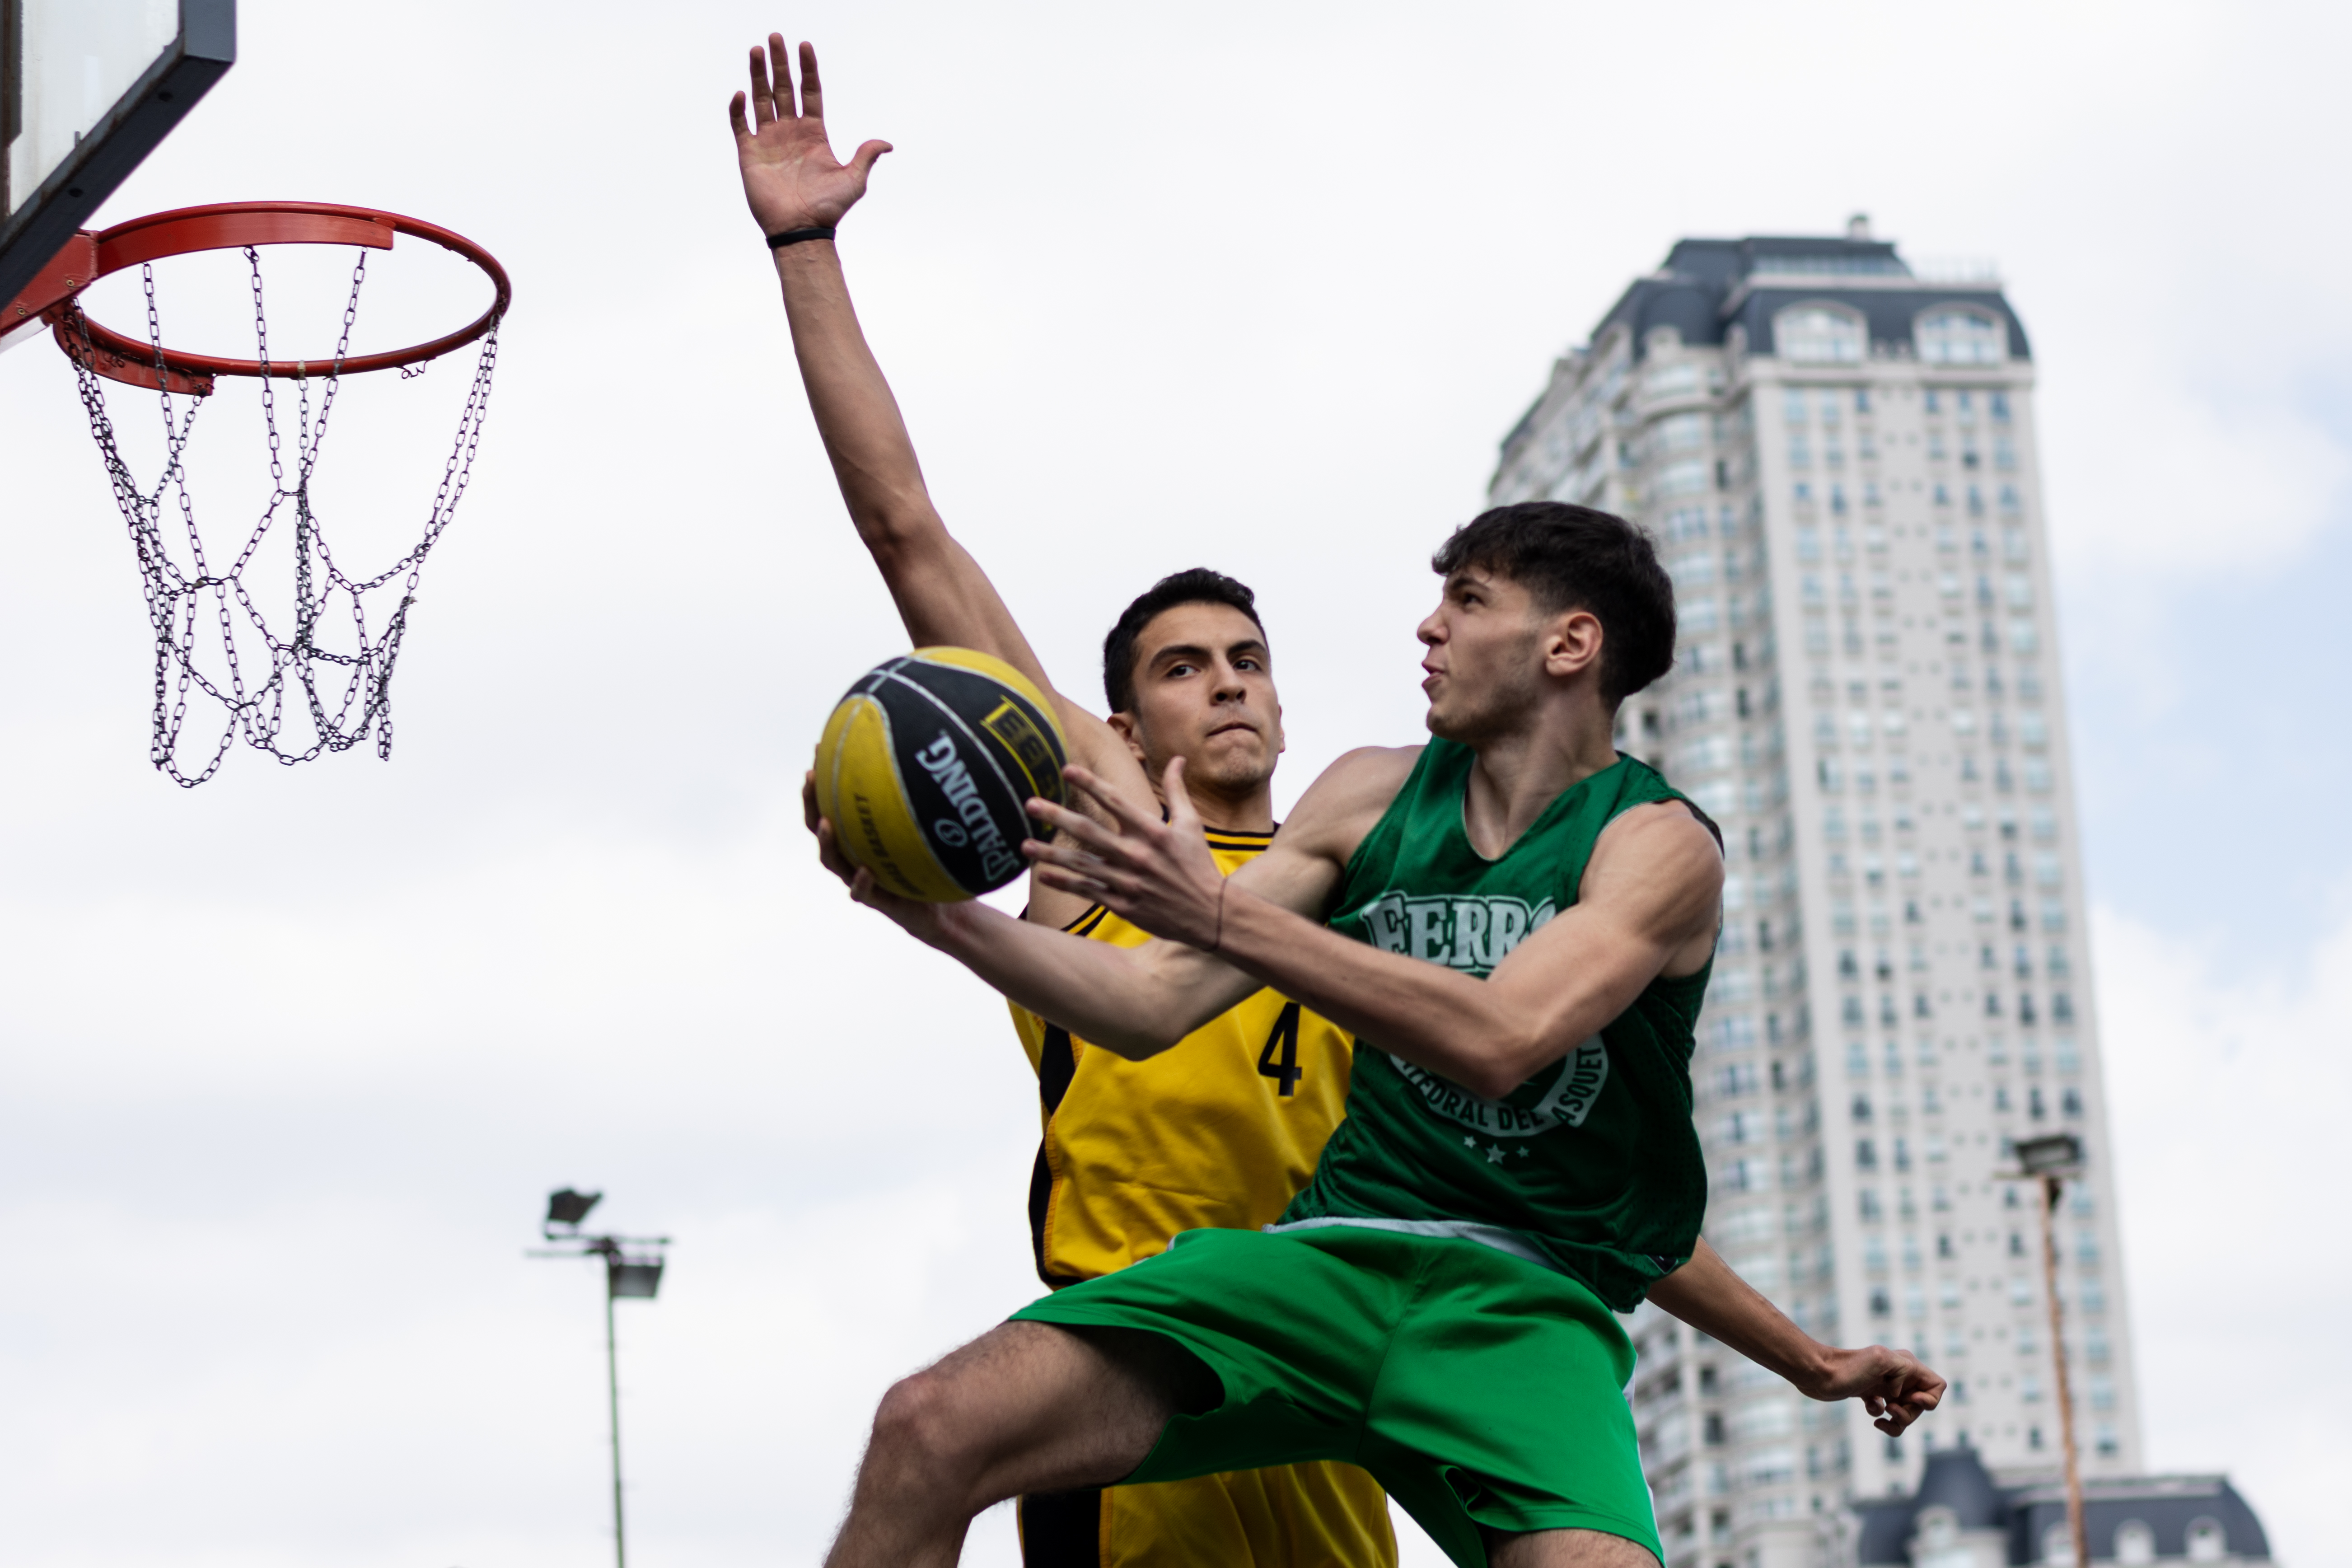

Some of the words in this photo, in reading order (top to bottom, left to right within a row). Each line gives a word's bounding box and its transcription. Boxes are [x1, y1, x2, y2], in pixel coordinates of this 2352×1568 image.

[914, 734, 1020, 882] SPALDING
[1258, 1001, 1302, 1096] 4
[1497, 1106, 1545, 1130] DEL
